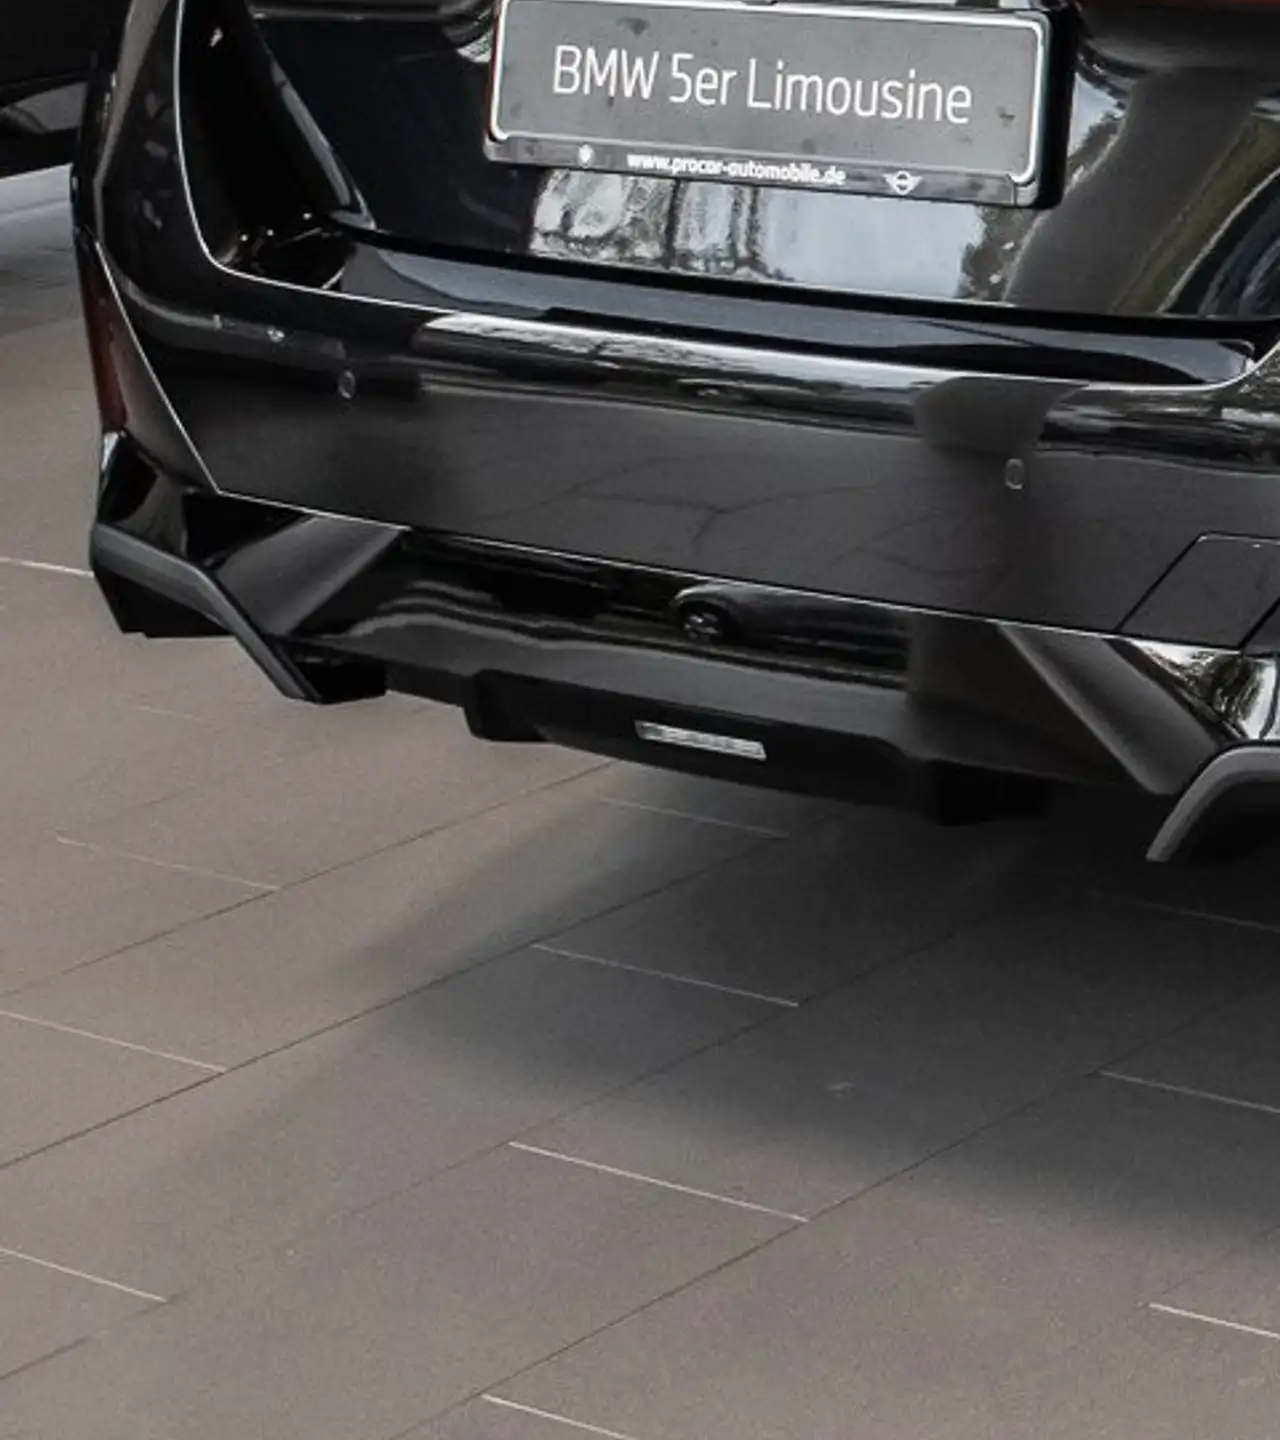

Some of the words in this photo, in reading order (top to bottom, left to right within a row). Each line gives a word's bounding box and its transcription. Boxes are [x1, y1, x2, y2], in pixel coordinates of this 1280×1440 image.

[553, 44, 660, 100] BMW
[668, 52, 737, 106] 5er
[747, 58, 972, 124] Limousine
[626, 152, 847, 186] www.procar-automobile.de
